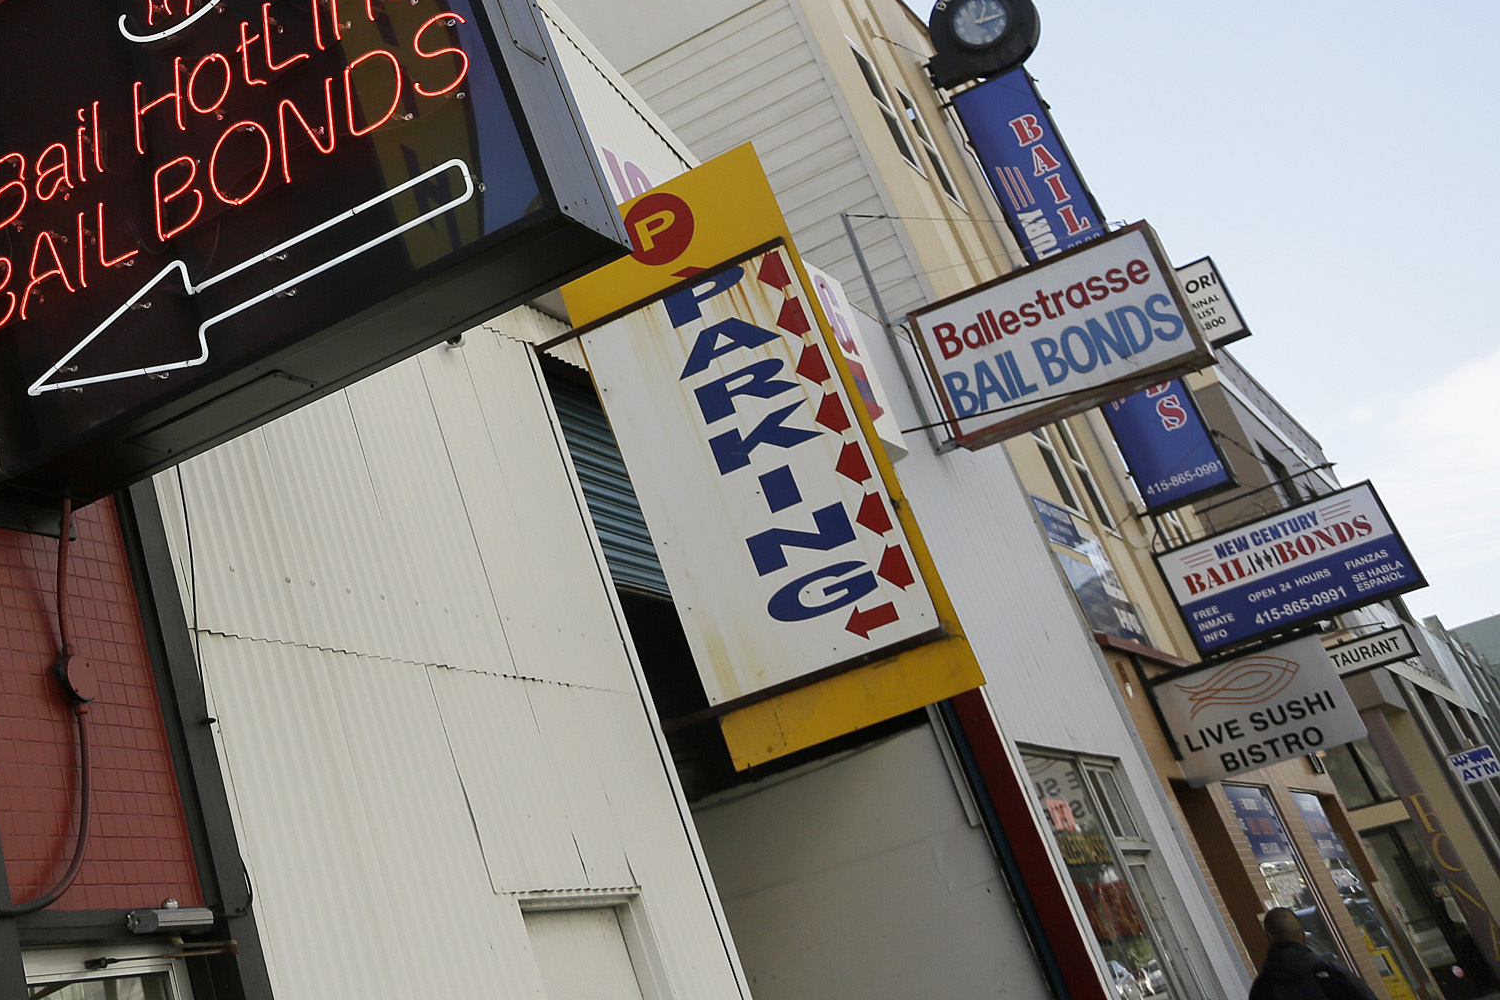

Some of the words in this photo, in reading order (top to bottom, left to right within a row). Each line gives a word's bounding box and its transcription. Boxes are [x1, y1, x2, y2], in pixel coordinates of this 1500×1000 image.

[154, 12, 469, 242] BONDS
[1008, 113, 1092, 237] BAIL
[634, 210, 676, 252] P
[1016, 208, 1063, 261] TURY
[1185, 272, 1217, 294] ORI
[932, 259, 1151, 360] Ballestrasse
[1191, 294, 1220, 309] INAL
[1197, 307, 1217, 319] LIST
[1202, 316, 1227, 331] 800
[943, 350, 1039, 418] BAIL
[1031, 293, 1185, 387] BONDS
[662, 264, 880, 623] PARKING
[1147, 460, 1224, 496] 415-865-0991
[1213, 535, 1250, 560] NEW
[1250, 510, 1320, 548] CENTURY
[1182, 558, 1253, 595] BAIL
[1273, 514, 1374, 564] BONDS
[1344, 549, 1389, 570] FIANZAS
[1351, 571, 1367, 583] SE
[1367, 560, 1404, 578] HABLA
[1248, 586, 1276, 602] OPEN
[1279, 581, 1292, 592] 24
[1294, 568, 1332, 587] HOURS
[1356, 571, 1405, 592] ESPANOL
[1192, 605, 1220, 621] FREE
[1198, 613, 1235, 632] INMATE
[1255, 586, 1348, 625] 415-865-0991
[1203, 629, 1228, 643] INFO
[1329, 636, 1400, 668] TAURANT
[1184, 718, 1245, 753] LIVE
[1248, 690, 1336, 732] SUSHI
[1219, 725, 1324, 773] BISTRO
[1462, 761, 1500, 781] ATM
